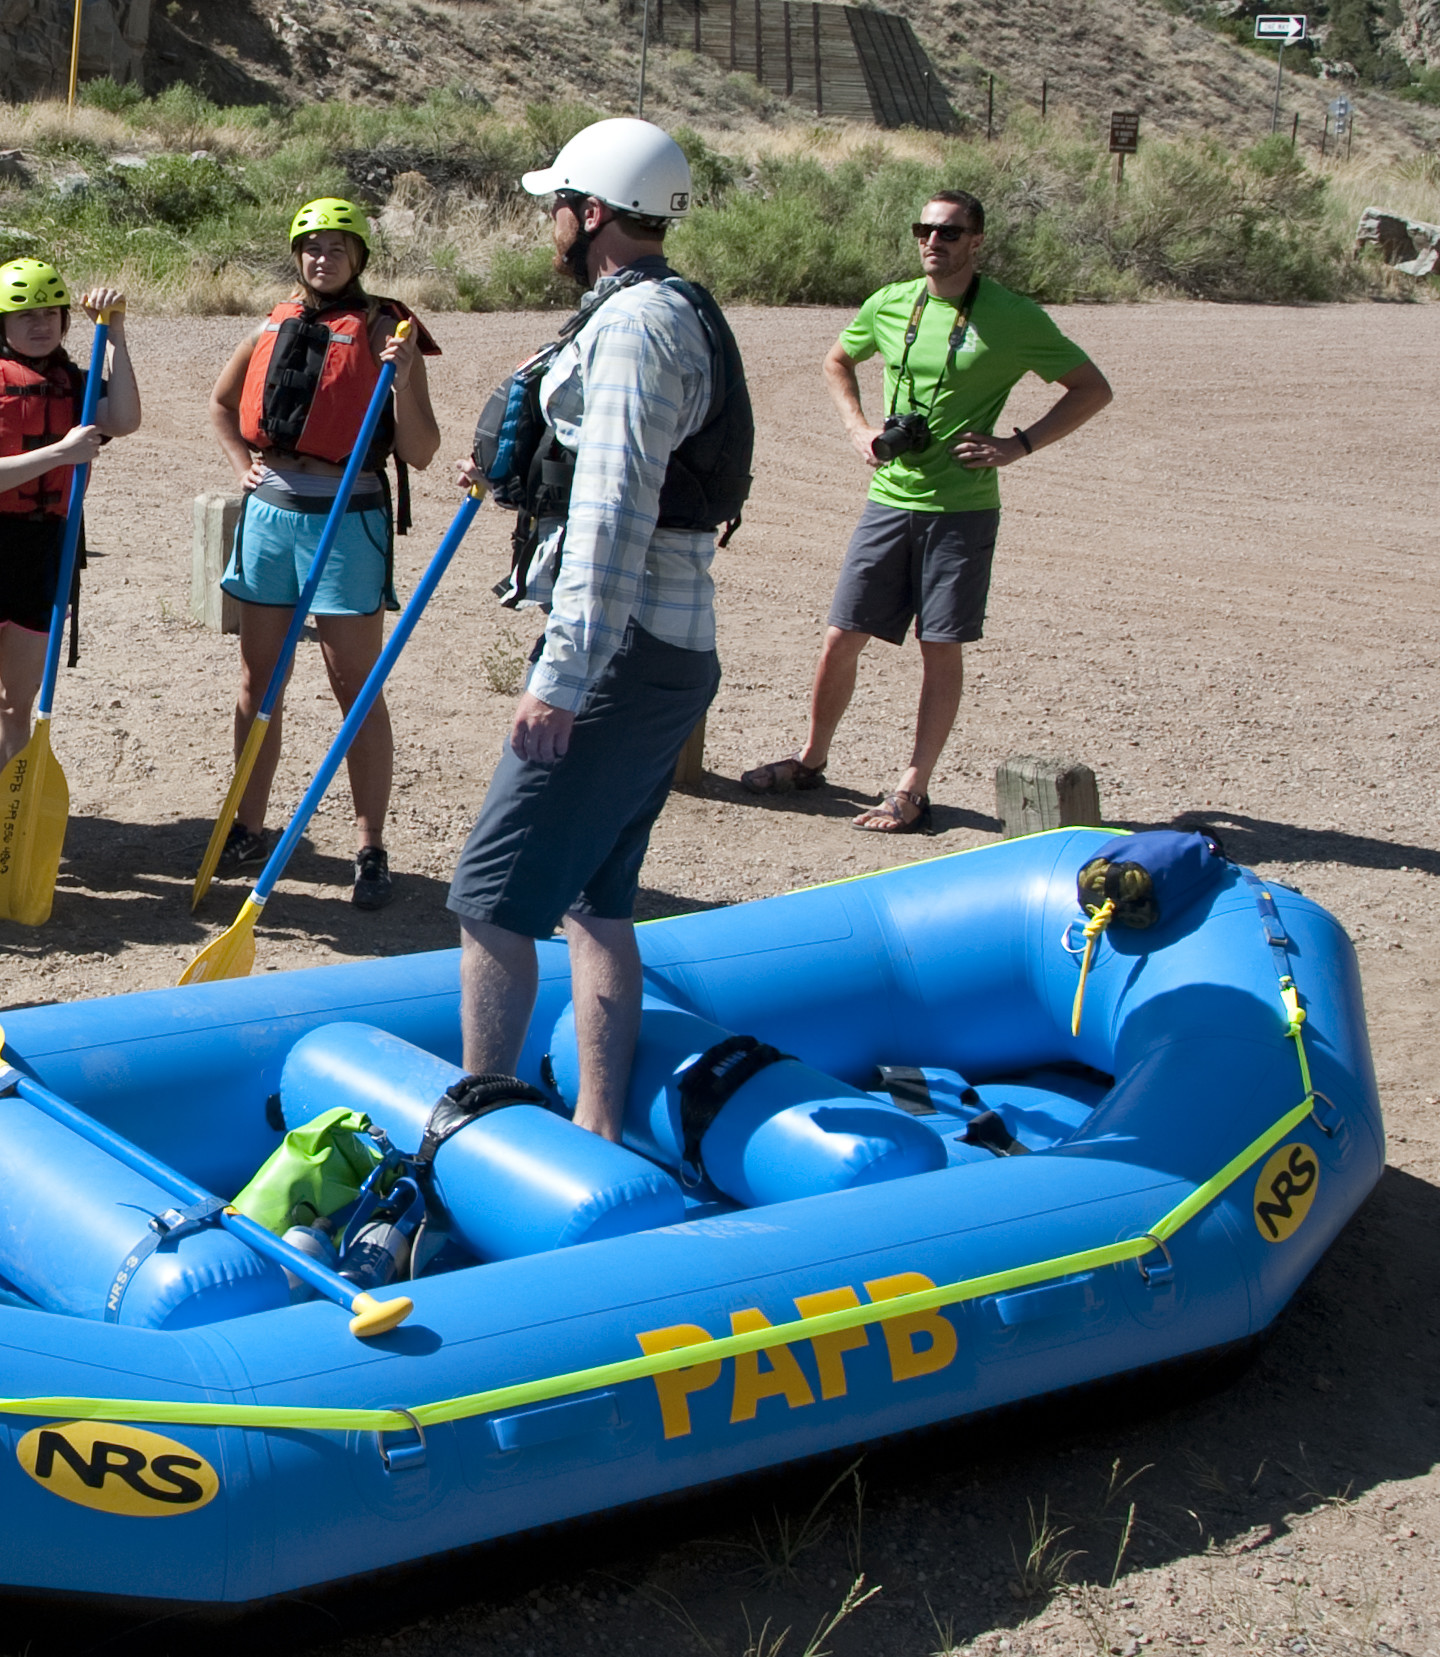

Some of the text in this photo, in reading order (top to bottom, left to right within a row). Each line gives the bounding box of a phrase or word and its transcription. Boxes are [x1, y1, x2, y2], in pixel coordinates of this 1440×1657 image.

[10, 759, 27, 793] PAFB
[1256, 1146, 1316, 1239] NRS
[635, 1271, 958, 1440] PAFB
[35, 1430, 203, 1504] NRS
